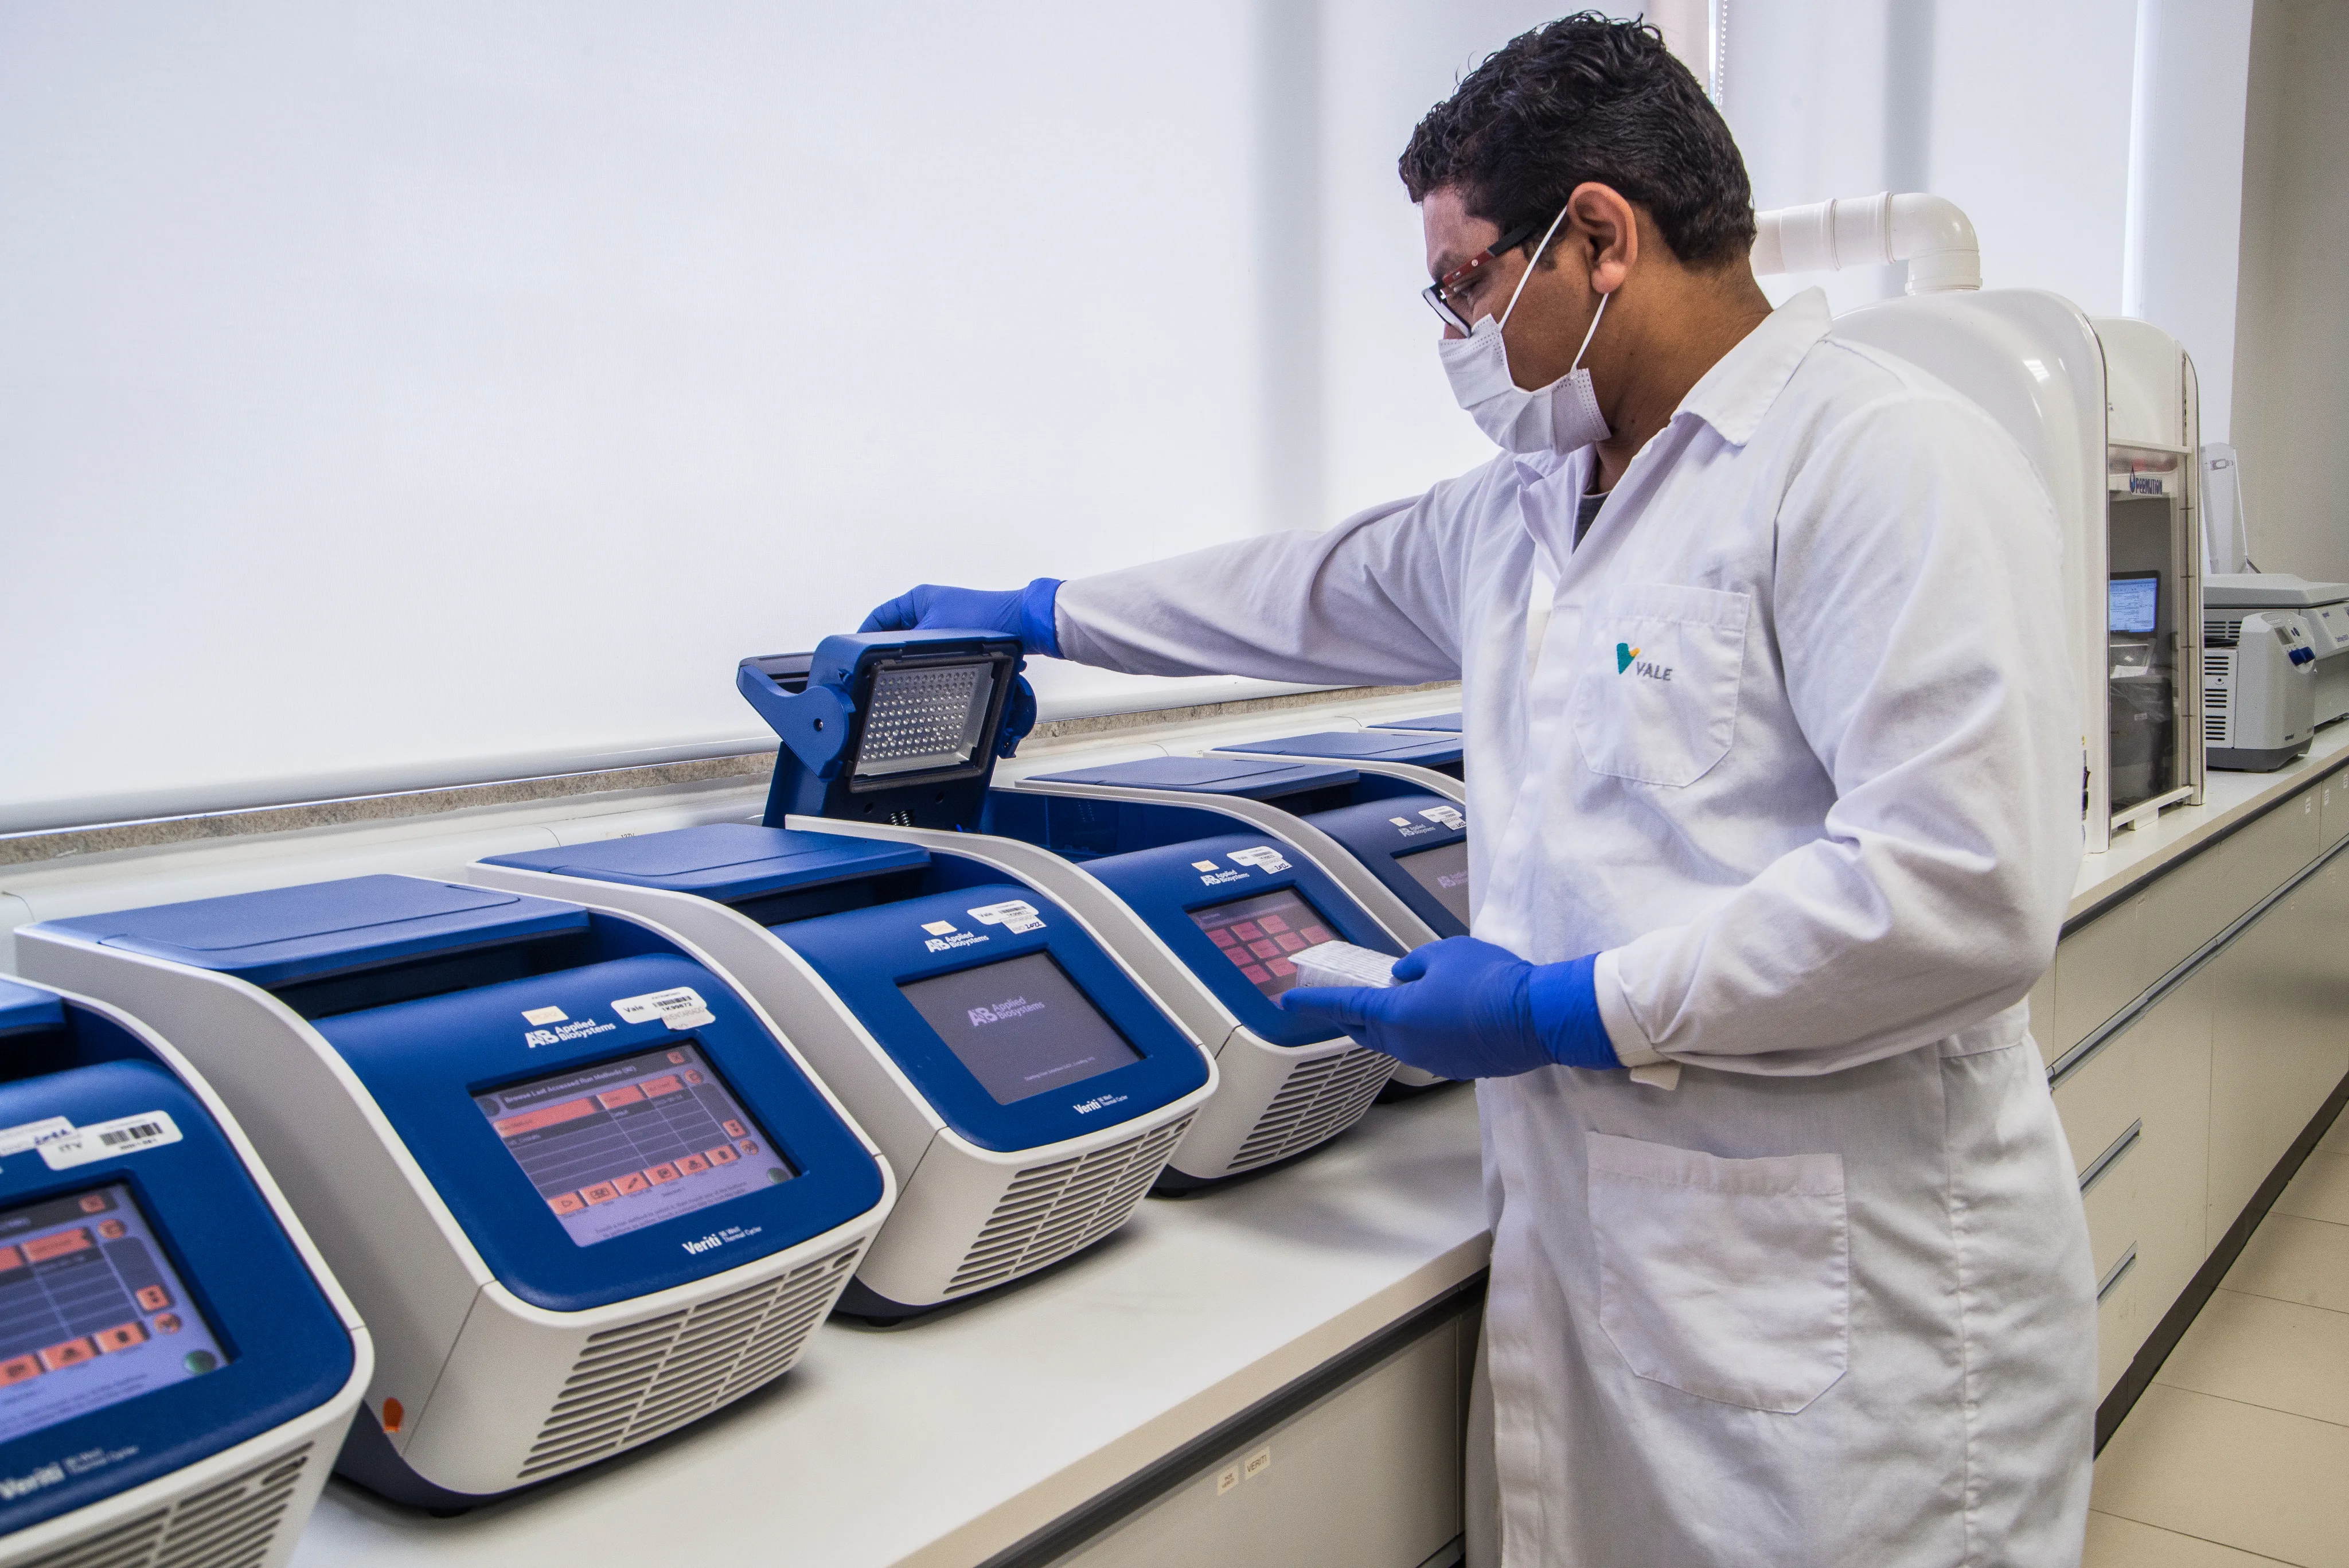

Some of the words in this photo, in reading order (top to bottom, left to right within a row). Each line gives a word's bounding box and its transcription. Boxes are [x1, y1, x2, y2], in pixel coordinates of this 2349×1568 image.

[1636, 661, 1673, 681] VALE
[1215, 869, 1238, 877] Applied
[1219, 873, 1250, 882] Biosystems
[945, 931, 974, 943] Applied
[950, 935, 990, 947] Biosystems
[623, 1005, 645, 1013] Vale
[992, 996, 1027, 1012] Applied
[996, 1001, 1045, 1020] Biosystems
[555, 1018, 596, 1035] Applied
[559, 1023, 616, 1041] Biosystems
[1073, 1099, 1102, 1114] Veriti
[681, 1233, 723, 1254] Veriti
[1247, 1454, 1267, 1472] VERITI
